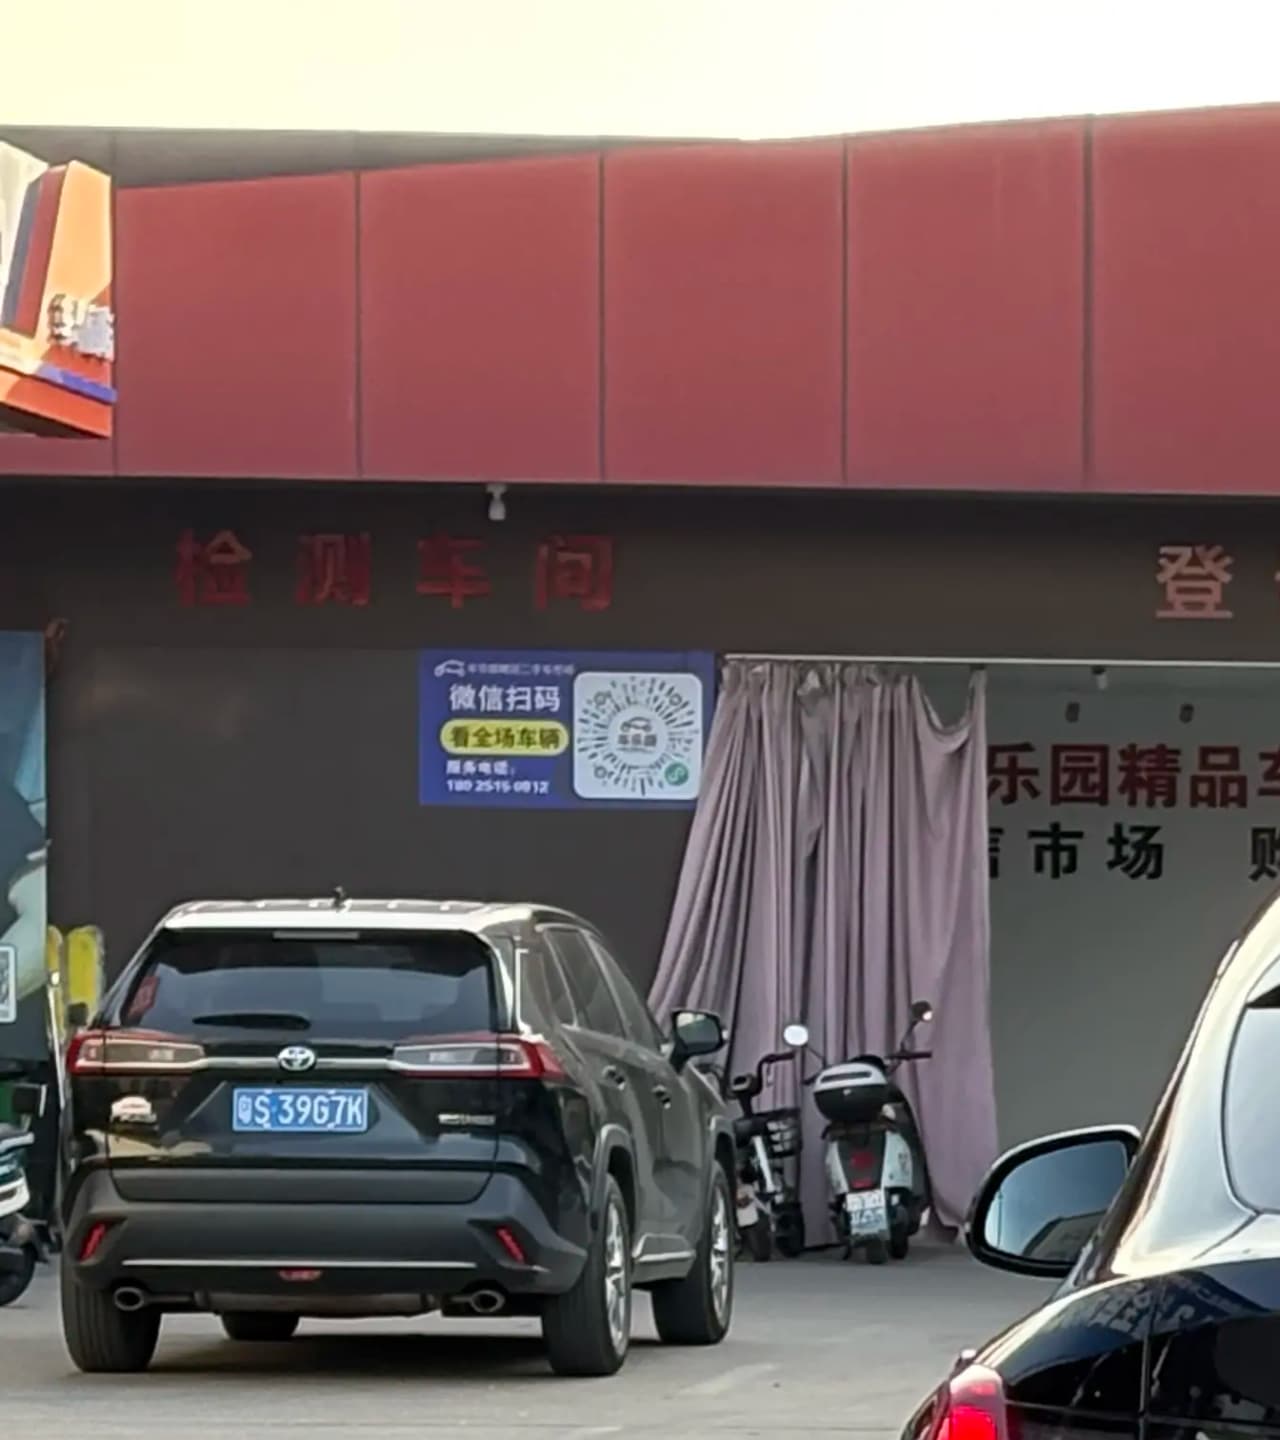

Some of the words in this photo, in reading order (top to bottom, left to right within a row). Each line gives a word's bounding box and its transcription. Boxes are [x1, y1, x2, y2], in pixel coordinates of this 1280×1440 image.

[173, 530, 615, 611] 检测车间
[449, 684, 561, 712] 微信扫码
[451, 726, 561, 749] 看全场车辆
